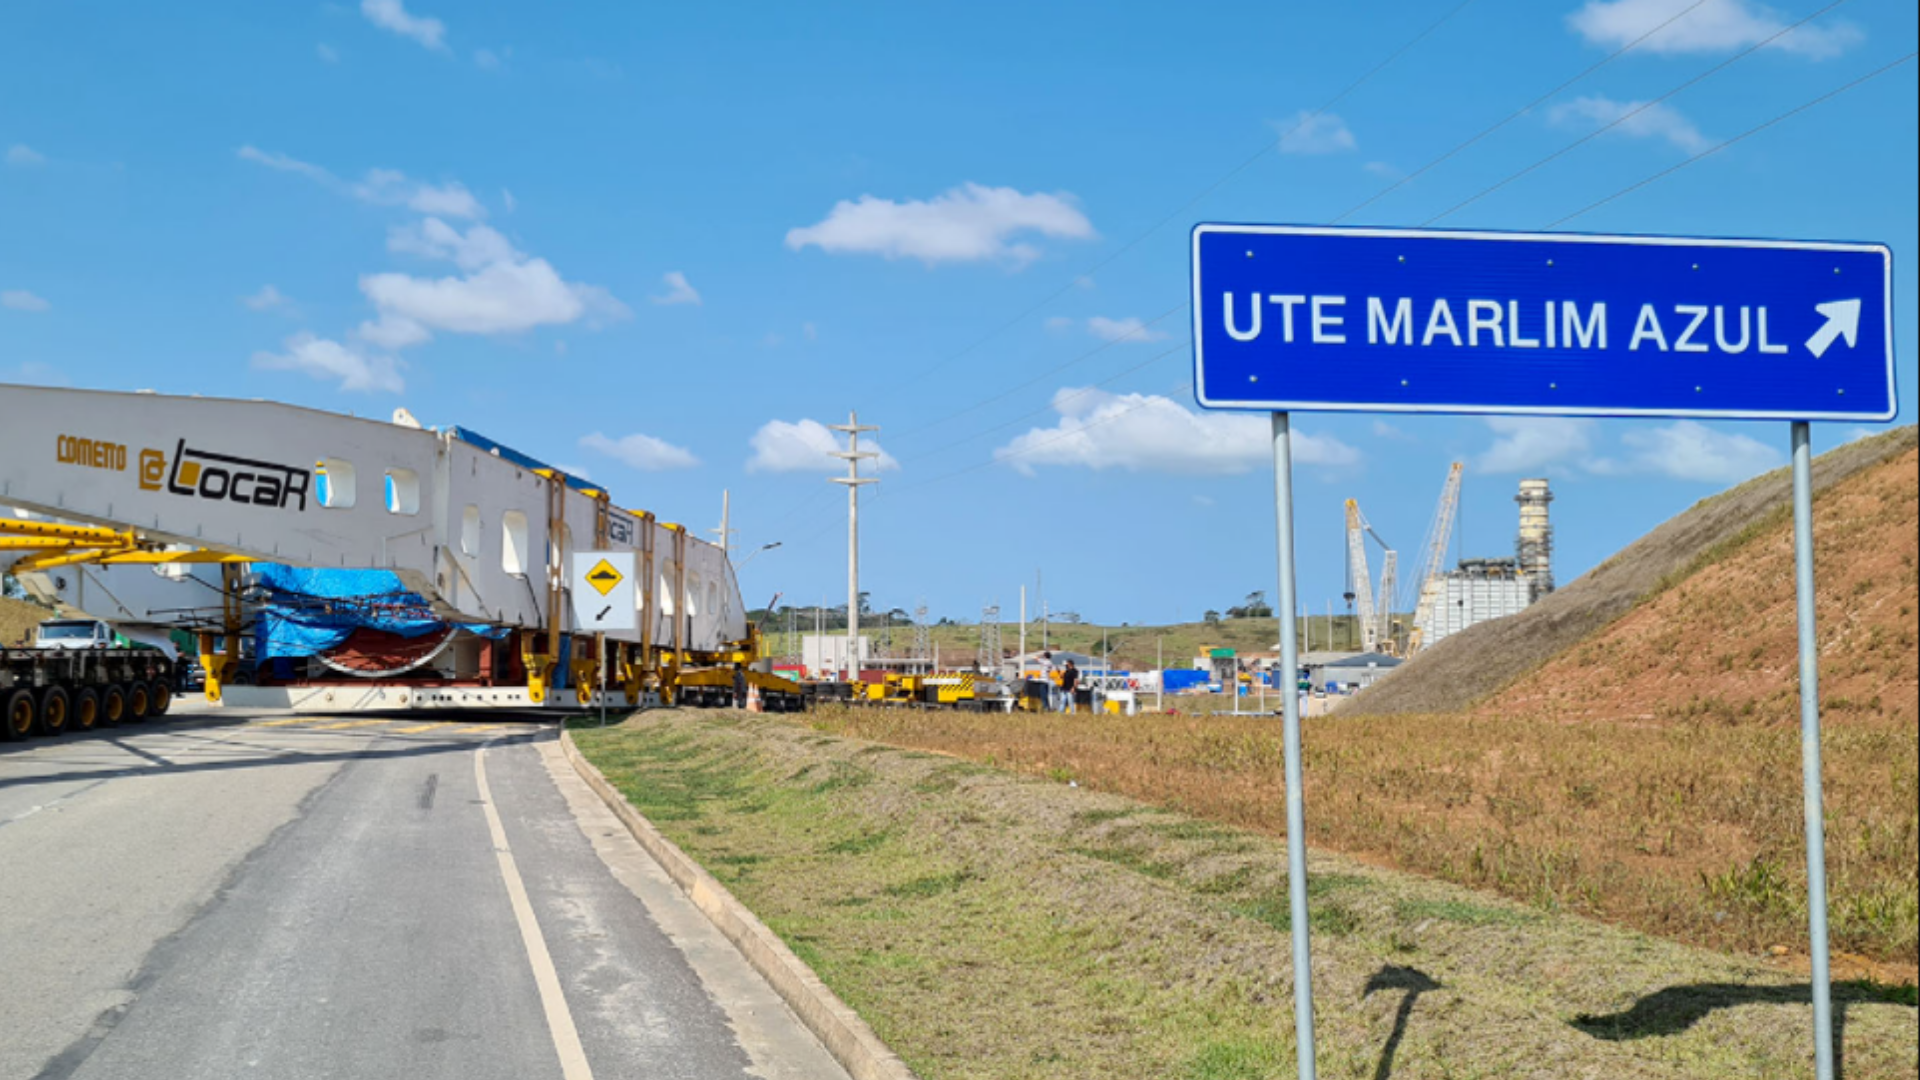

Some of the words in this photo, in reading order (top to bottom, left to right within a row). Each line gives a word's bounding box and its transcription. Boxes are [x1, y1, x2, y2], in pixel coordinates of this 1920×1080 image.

[1223, 292, 1346, 343] UTE
[1367, 297, 1607, 348] MARLIM
[1629, 304, 1788, 353] AZUL
